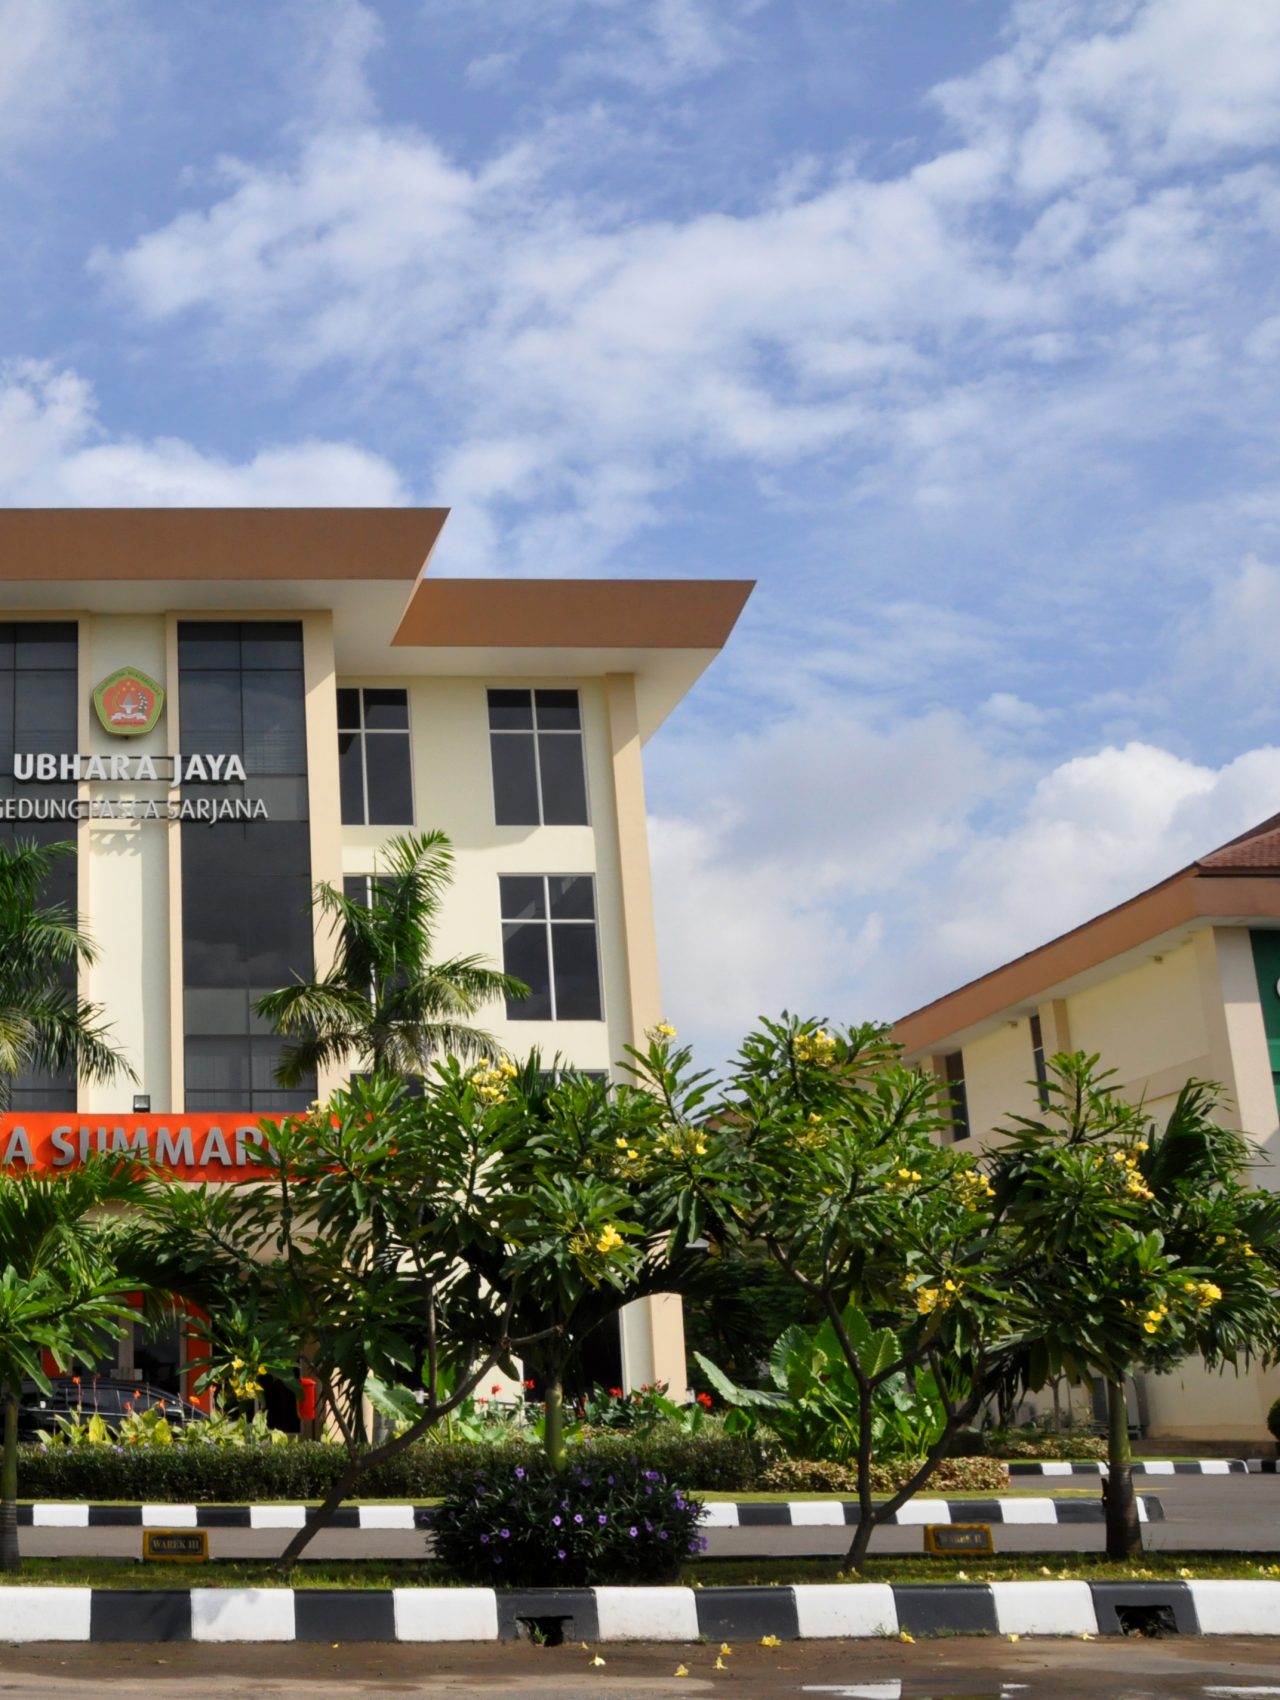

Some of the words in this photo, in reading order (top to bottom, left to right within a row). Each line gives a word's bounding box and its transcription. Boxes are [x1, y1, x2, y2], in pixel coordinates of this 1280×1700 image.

[13, 753, 160, 780] UBHARA
[169, 754, 247, 787] JAYA
[167, 799, 269, 824] SARJANA
[152, 1539, 186, 1550] WAREK
[188, 1539, 200, 1550] III
